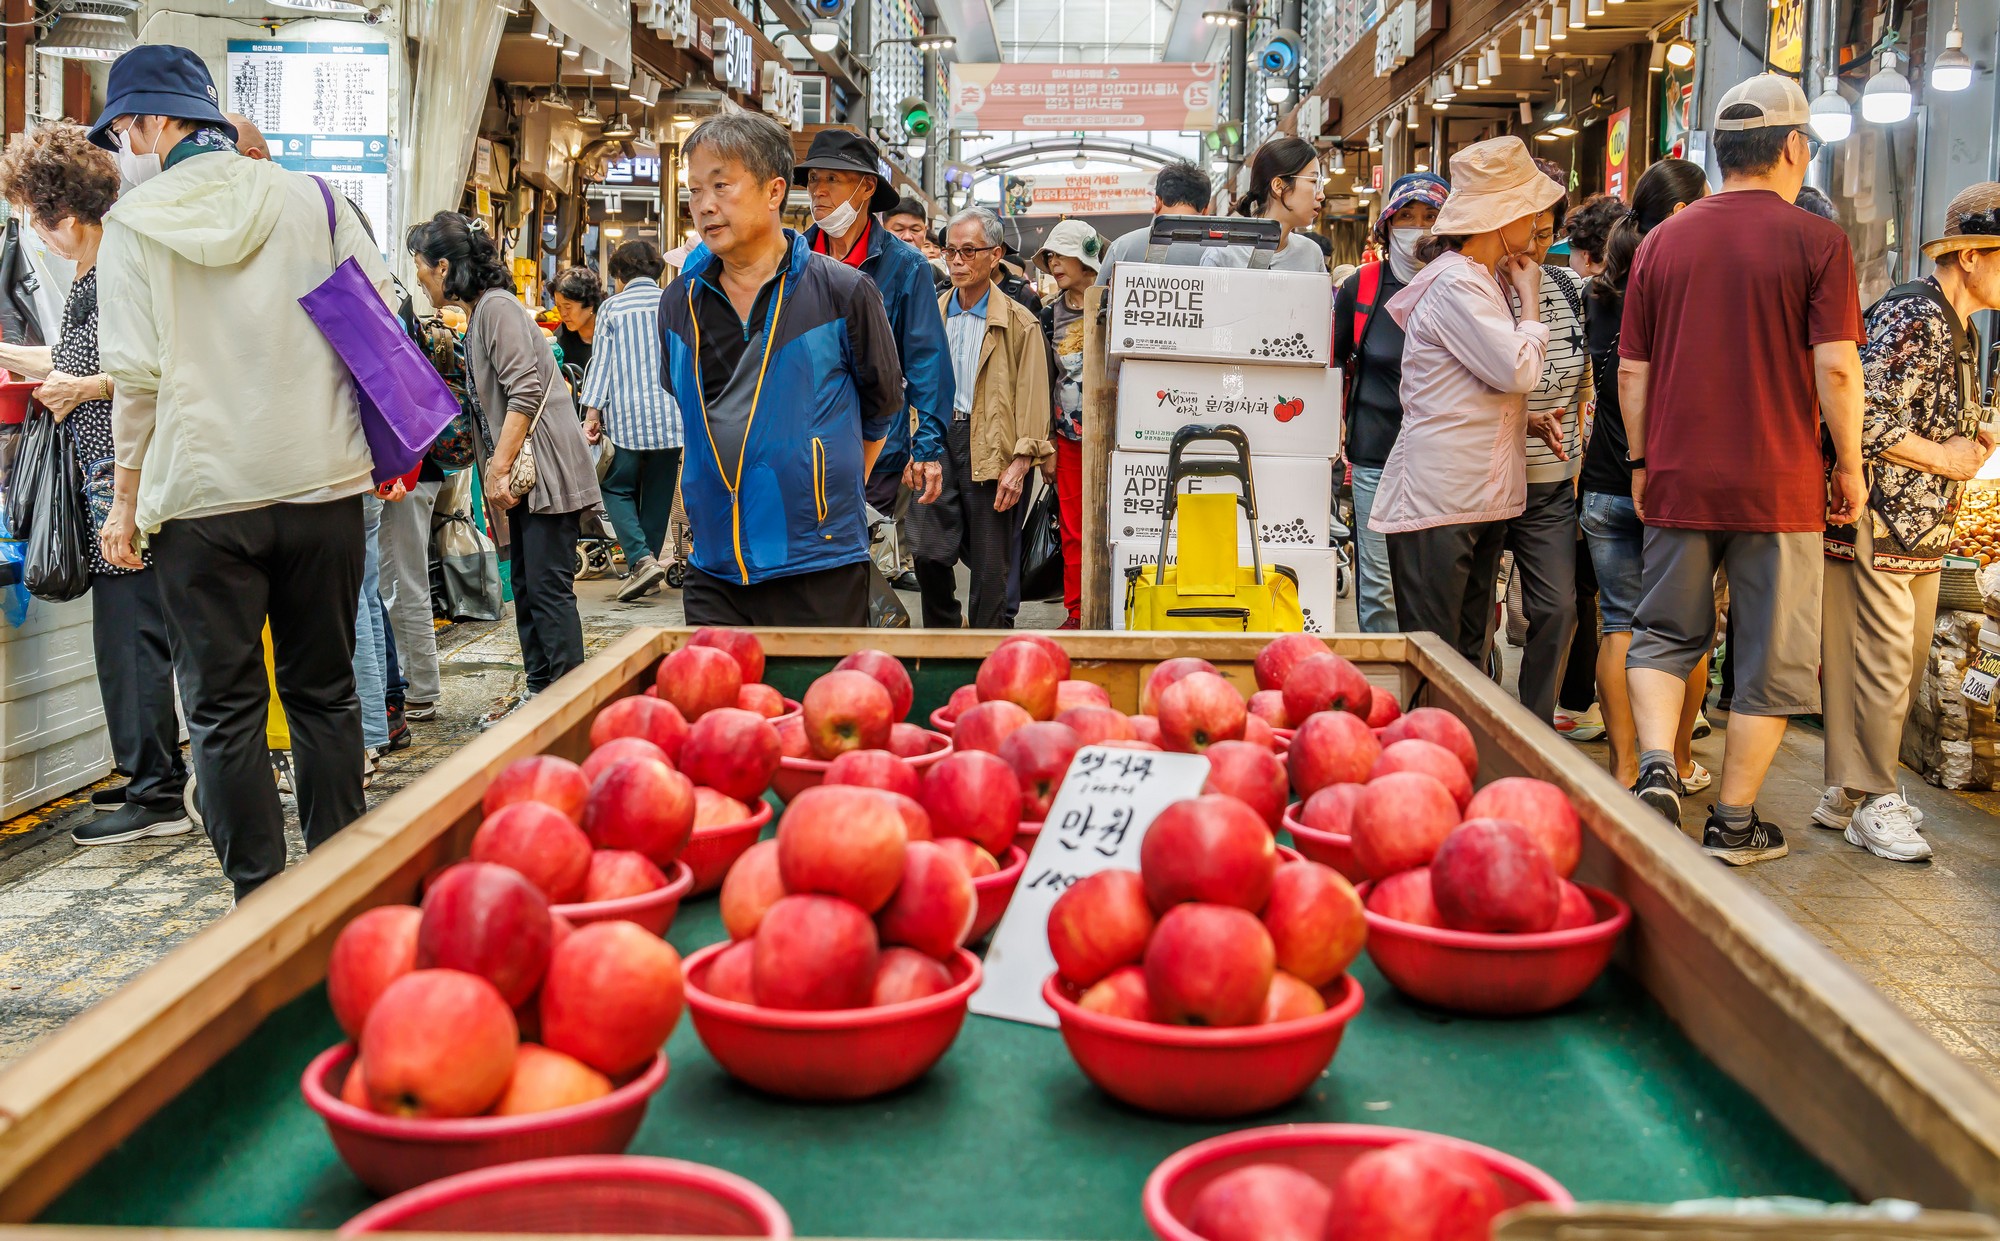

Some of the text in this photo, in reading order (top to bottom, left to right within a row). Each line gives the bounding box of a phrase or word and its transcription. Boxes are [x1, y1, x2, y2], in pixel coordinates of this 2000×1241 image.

[1126, 276, 1204, 292] HANWOORI
[1124, 289, 1203, 311] APPLE
[1124, 309, 1204, 329] 한우리사과
[1878, 801, 1894, 810] FILA
[1058, 804, 1134, 856] 만원
